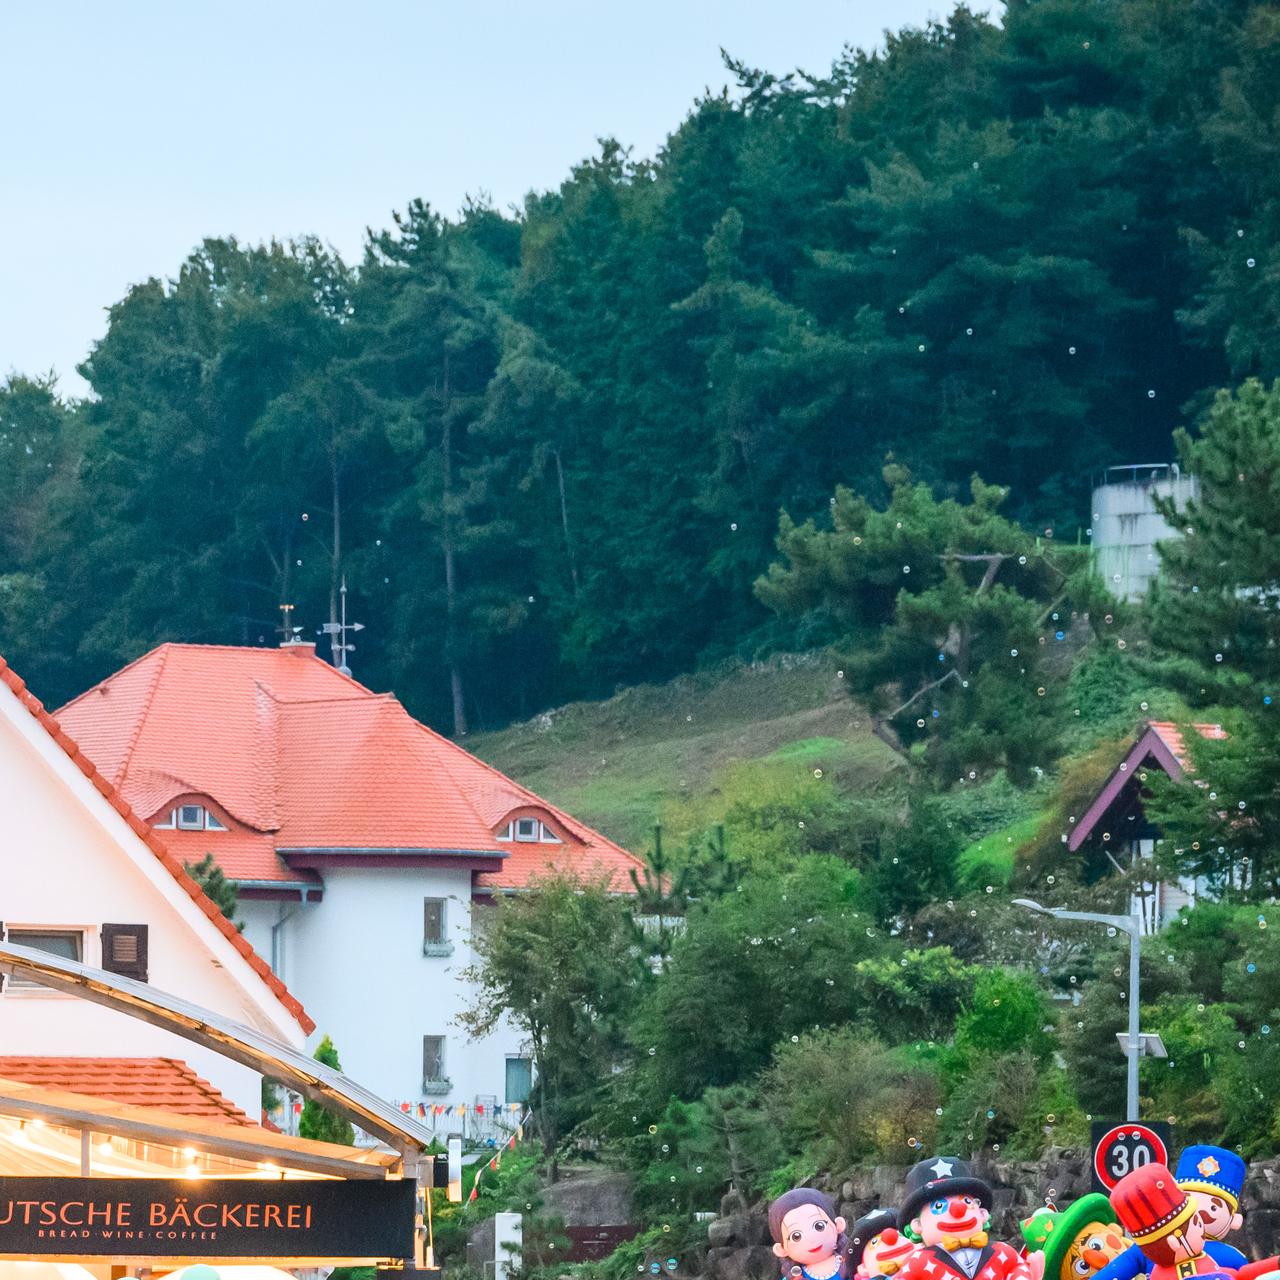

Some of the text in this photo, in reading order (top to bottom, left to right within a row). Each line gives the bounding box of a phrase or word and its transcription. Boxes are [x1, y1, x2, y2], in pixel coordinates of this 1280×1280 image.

[1112, 1144, 1151, 1177] 30
[149, 1198, 312, 1229] BÄCKEREI
[38, 1229, 218, 1241] BREAD WINE COFFEE
